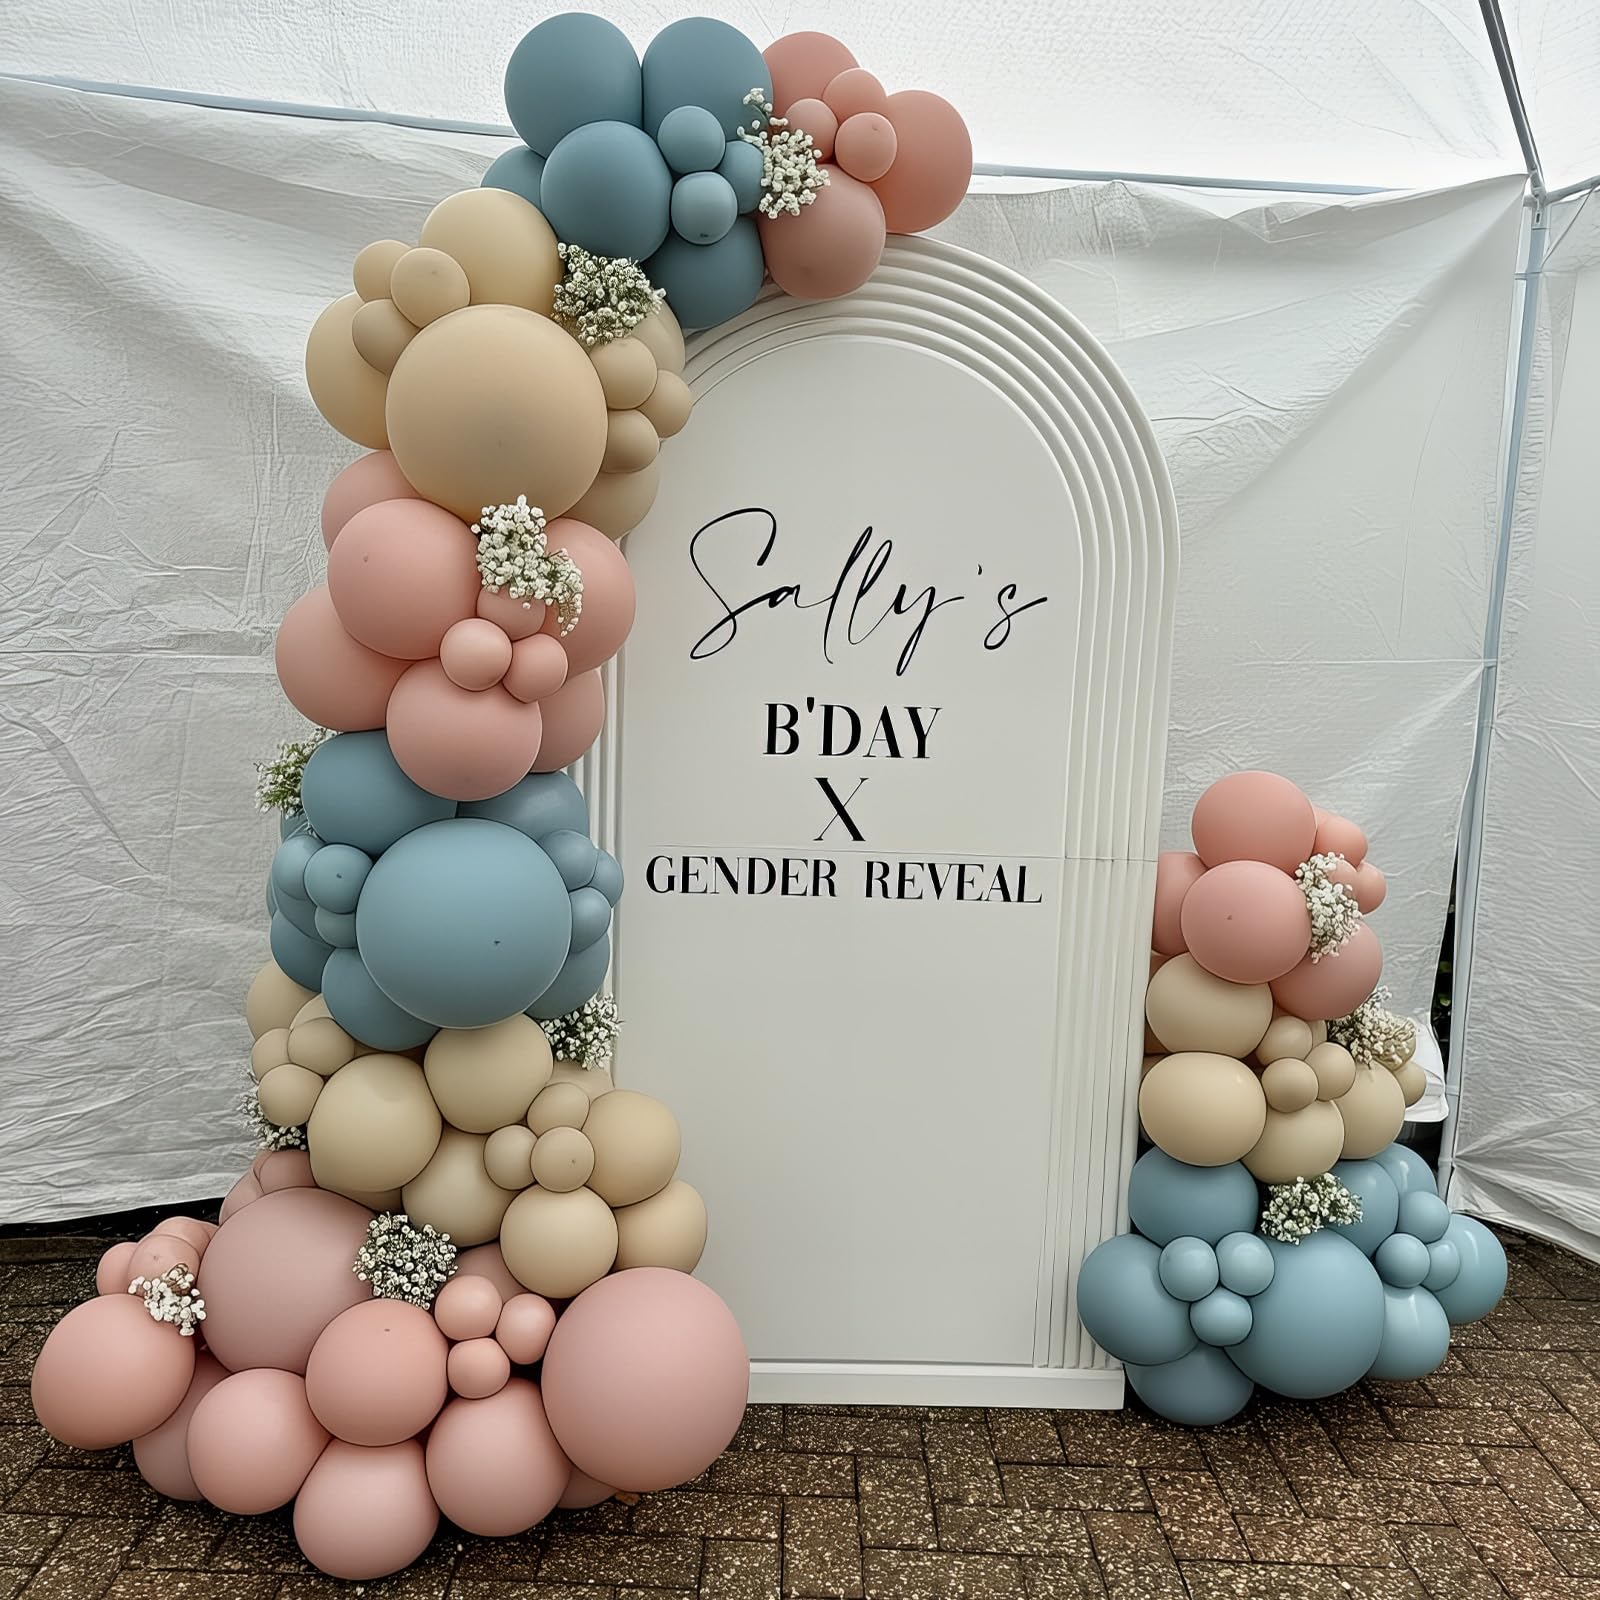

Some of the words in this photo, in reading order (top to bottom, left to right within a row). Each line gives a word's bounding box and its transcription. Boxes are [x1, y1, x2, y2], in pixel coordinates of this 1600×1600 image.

[689, 507, 1048, 677] Sally's
[762, 696, 943, 759] B'DAY
[813, 777, 869, 842] X
[645, 855, 837, 898] GENDER
[865, 860, 1043, 904] REVEAL
